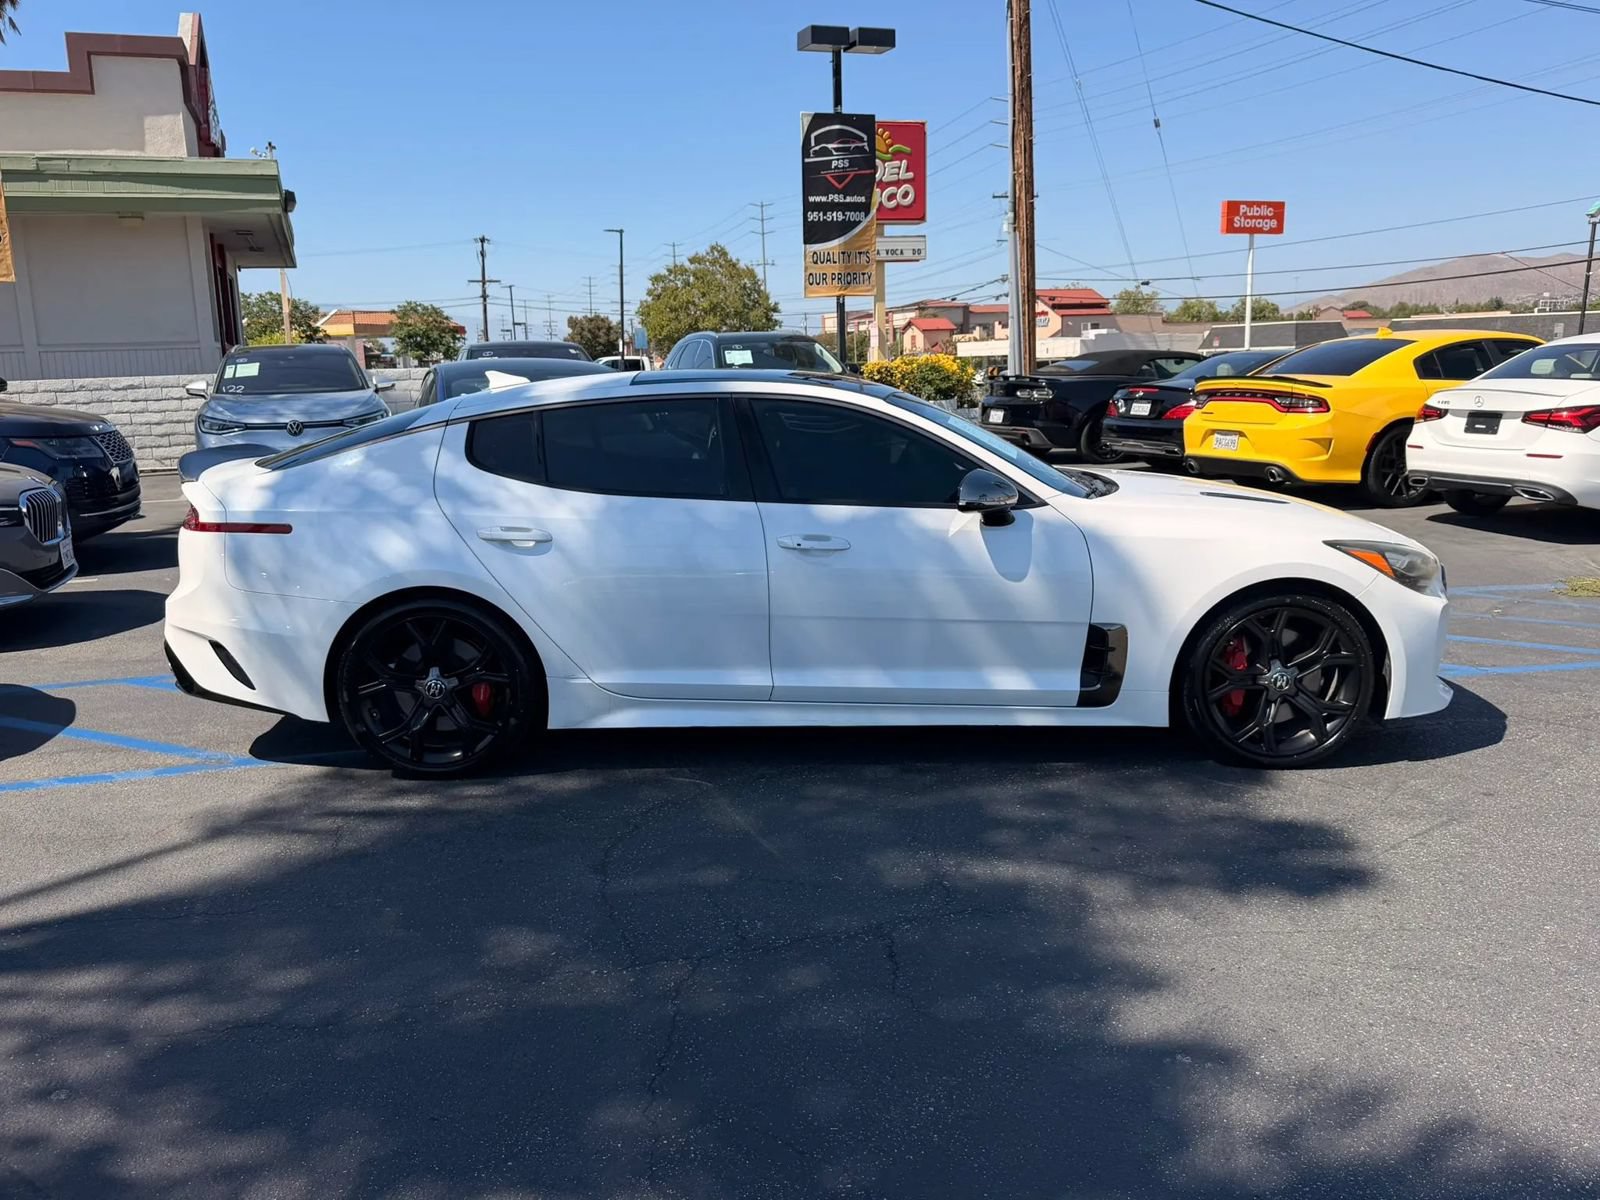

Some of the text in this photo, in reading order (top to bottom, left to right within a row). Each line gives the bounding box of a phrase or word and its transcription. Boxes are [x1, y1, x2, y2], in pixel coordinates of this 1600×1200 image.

[832, 159, 849, 168] PSS
[808, 194, 865, 202] www.PSS.autos
[876, 184, 914, 208] CO
[807, 211, 866, 221] 951-519-7008
[1239, 204, 1274, 216] Public
[1233, 216, 1277, 230] Storage
[812, 250, 871, 265] QUALITY IT'S
[808, 272, 872, 285] OUR PRIORITY
